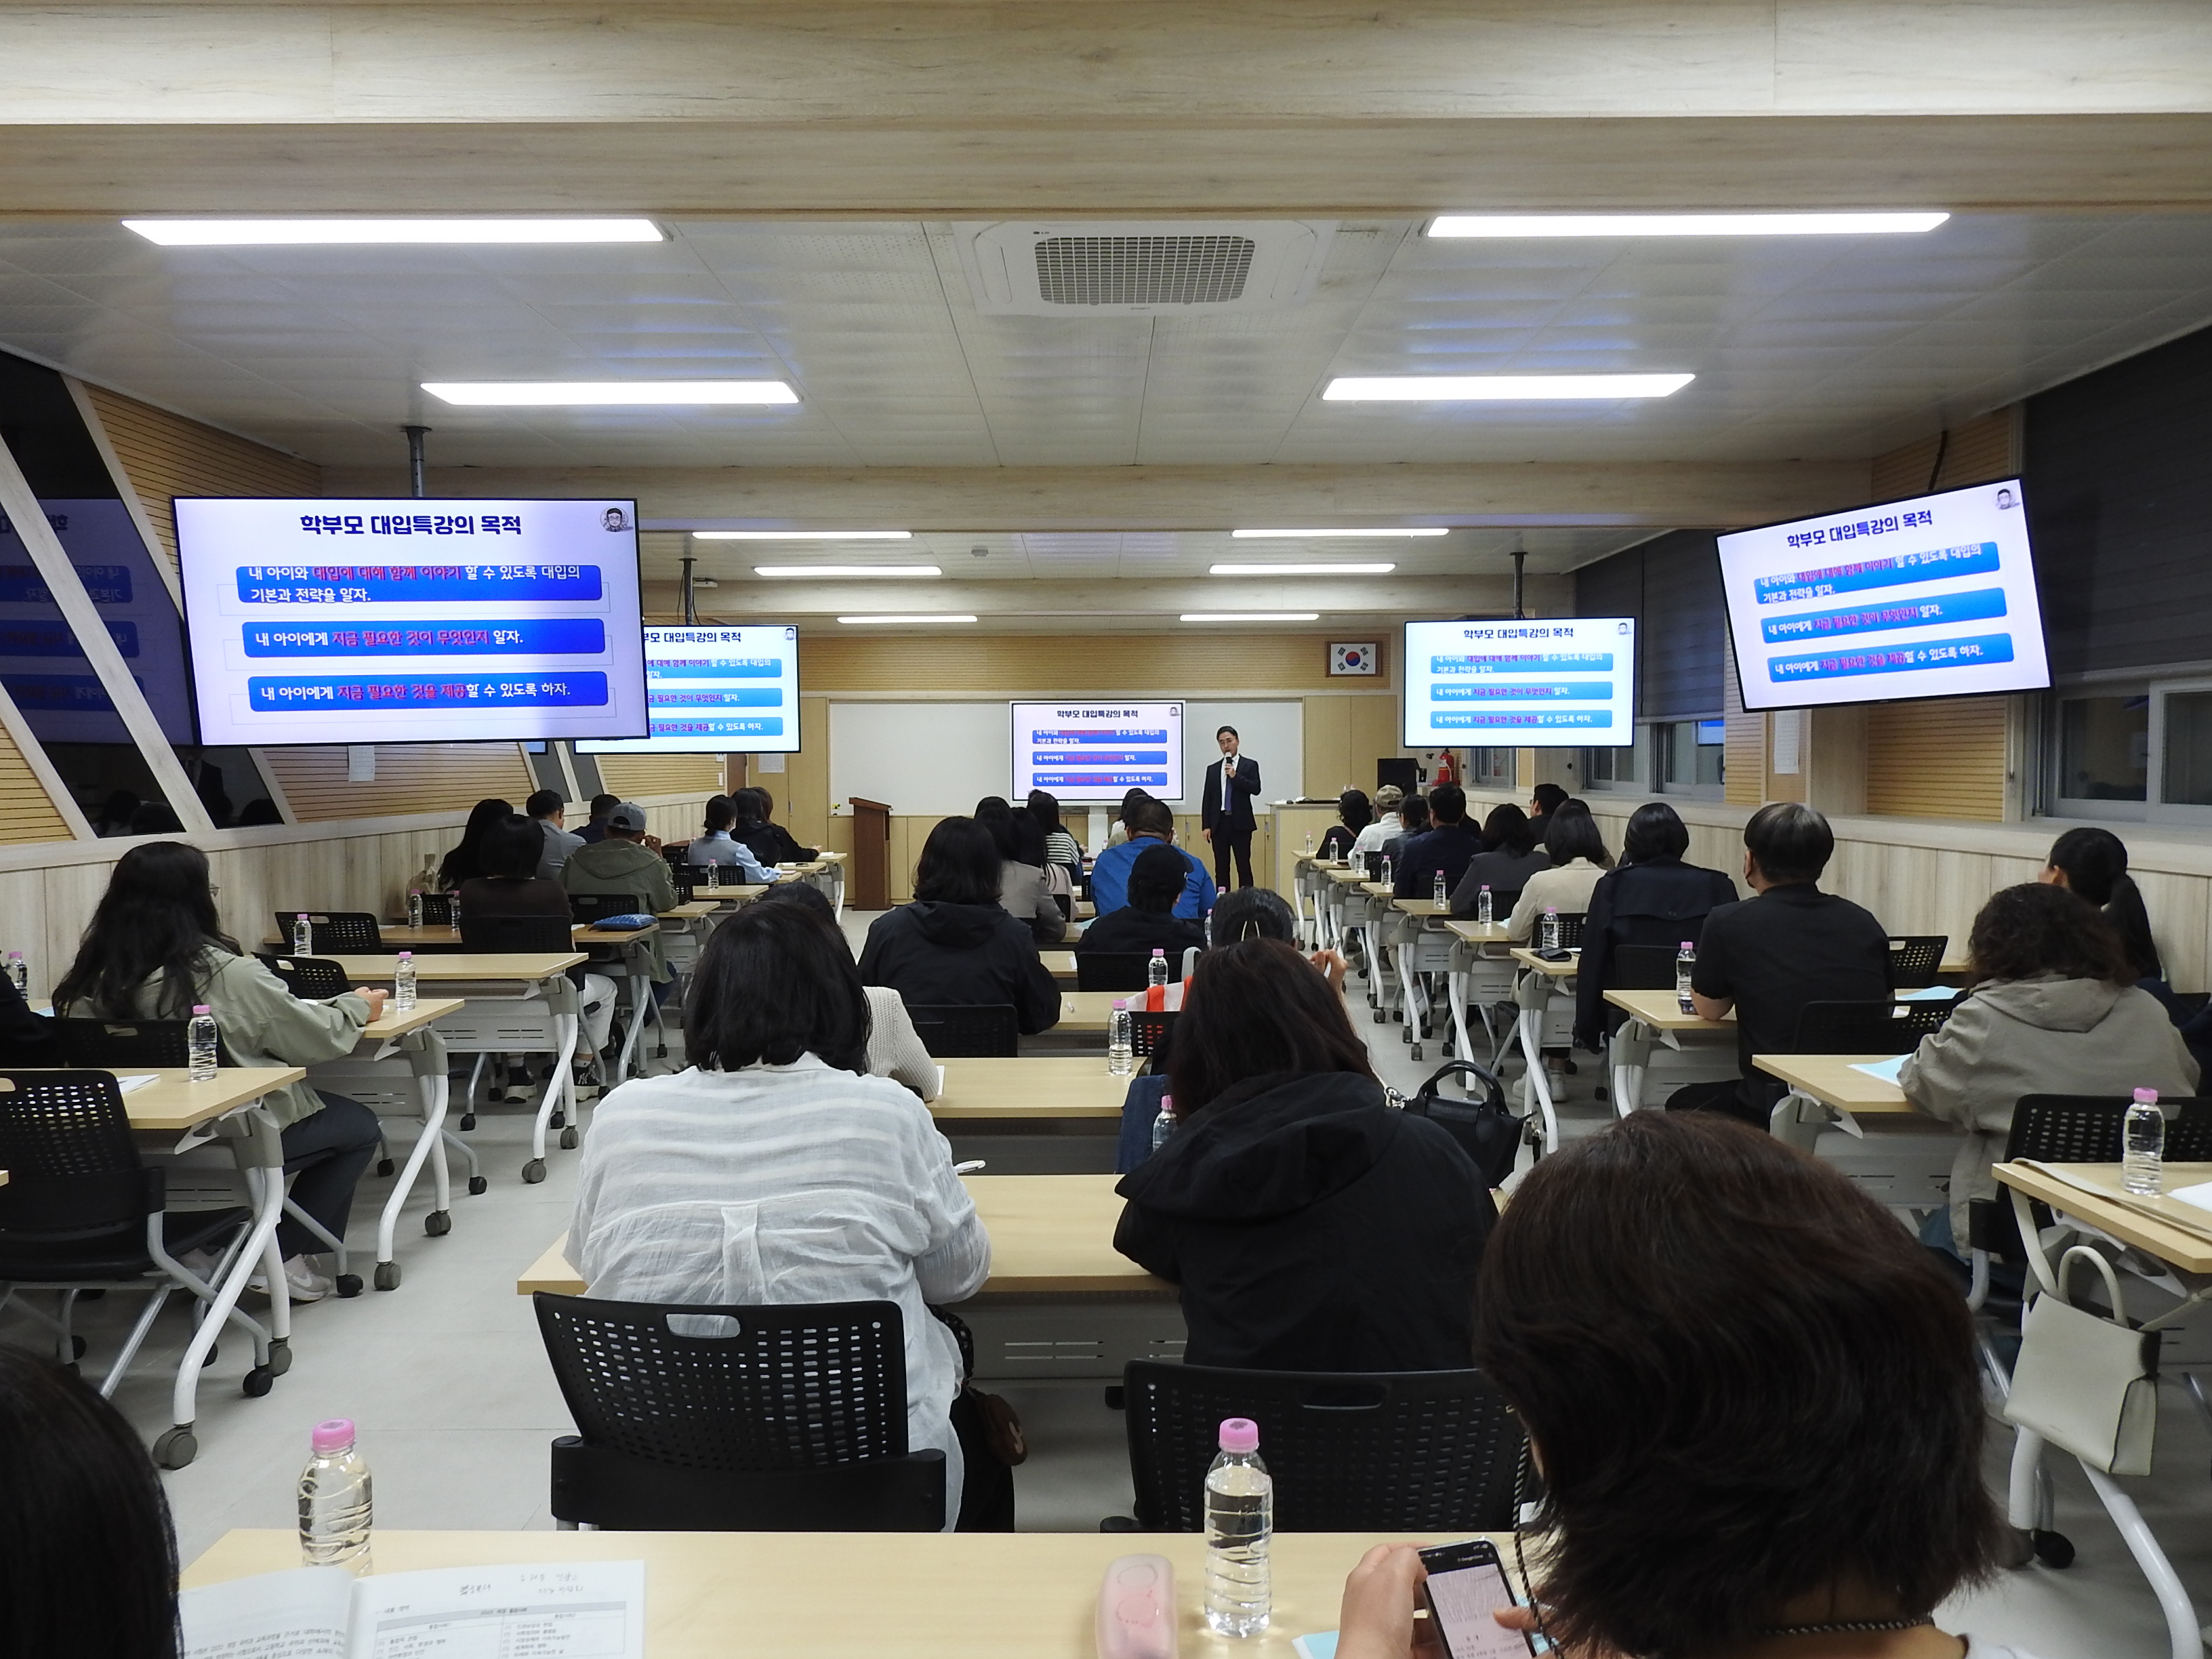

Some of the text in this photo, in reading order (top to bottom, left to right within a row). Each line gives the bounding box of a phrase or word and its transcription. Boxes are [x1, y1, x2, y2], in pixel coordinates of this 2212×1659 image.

[300, 515, 521, 535] 학부모 대입특강의 목적
[1787, 510, 1932, 548] 학부모 대입특강의 목적
[249, 565, 580, 581] 내 아이와 대입에 대해 함께 이야기 할 수 있도록 대입의
[1761, 544, 1981, 588] 내 아이와 대입에 대해 함께 이야기 할 수 있도록 대입의
[251, 588, 371, 604] 기본과 전략을 알자.
[1763, 585, 1835, 604] 기본과 전략을 알자.
[1768, 605, 1942, 635] 내 아이에게 지금 필요한 것이 무엇인지 알자.
[256, 629, 524, 647] 내 아이에게 지금 필요한 것이 무엇인지 알자.
[664, 632, 716, 642] 대입특강의
[720, 632, 741, 642] 목적
[1775, 644, 1983, 674] 내 아이에게 지금 필요한 것을 제공할 수 있도록 하자.
[647, 670, 662, 678] 알자.
[262, 682, 571, 701] 내 아이에게 지금 필요한 것을 제공할 수 있도록 하자.
[695, 694, 722, 702] 무엇인지
[724, 694, 739, 702] 알자.
[696, 723, 715, 731] 제공할
[748, 722, 763, 731] 하자.
